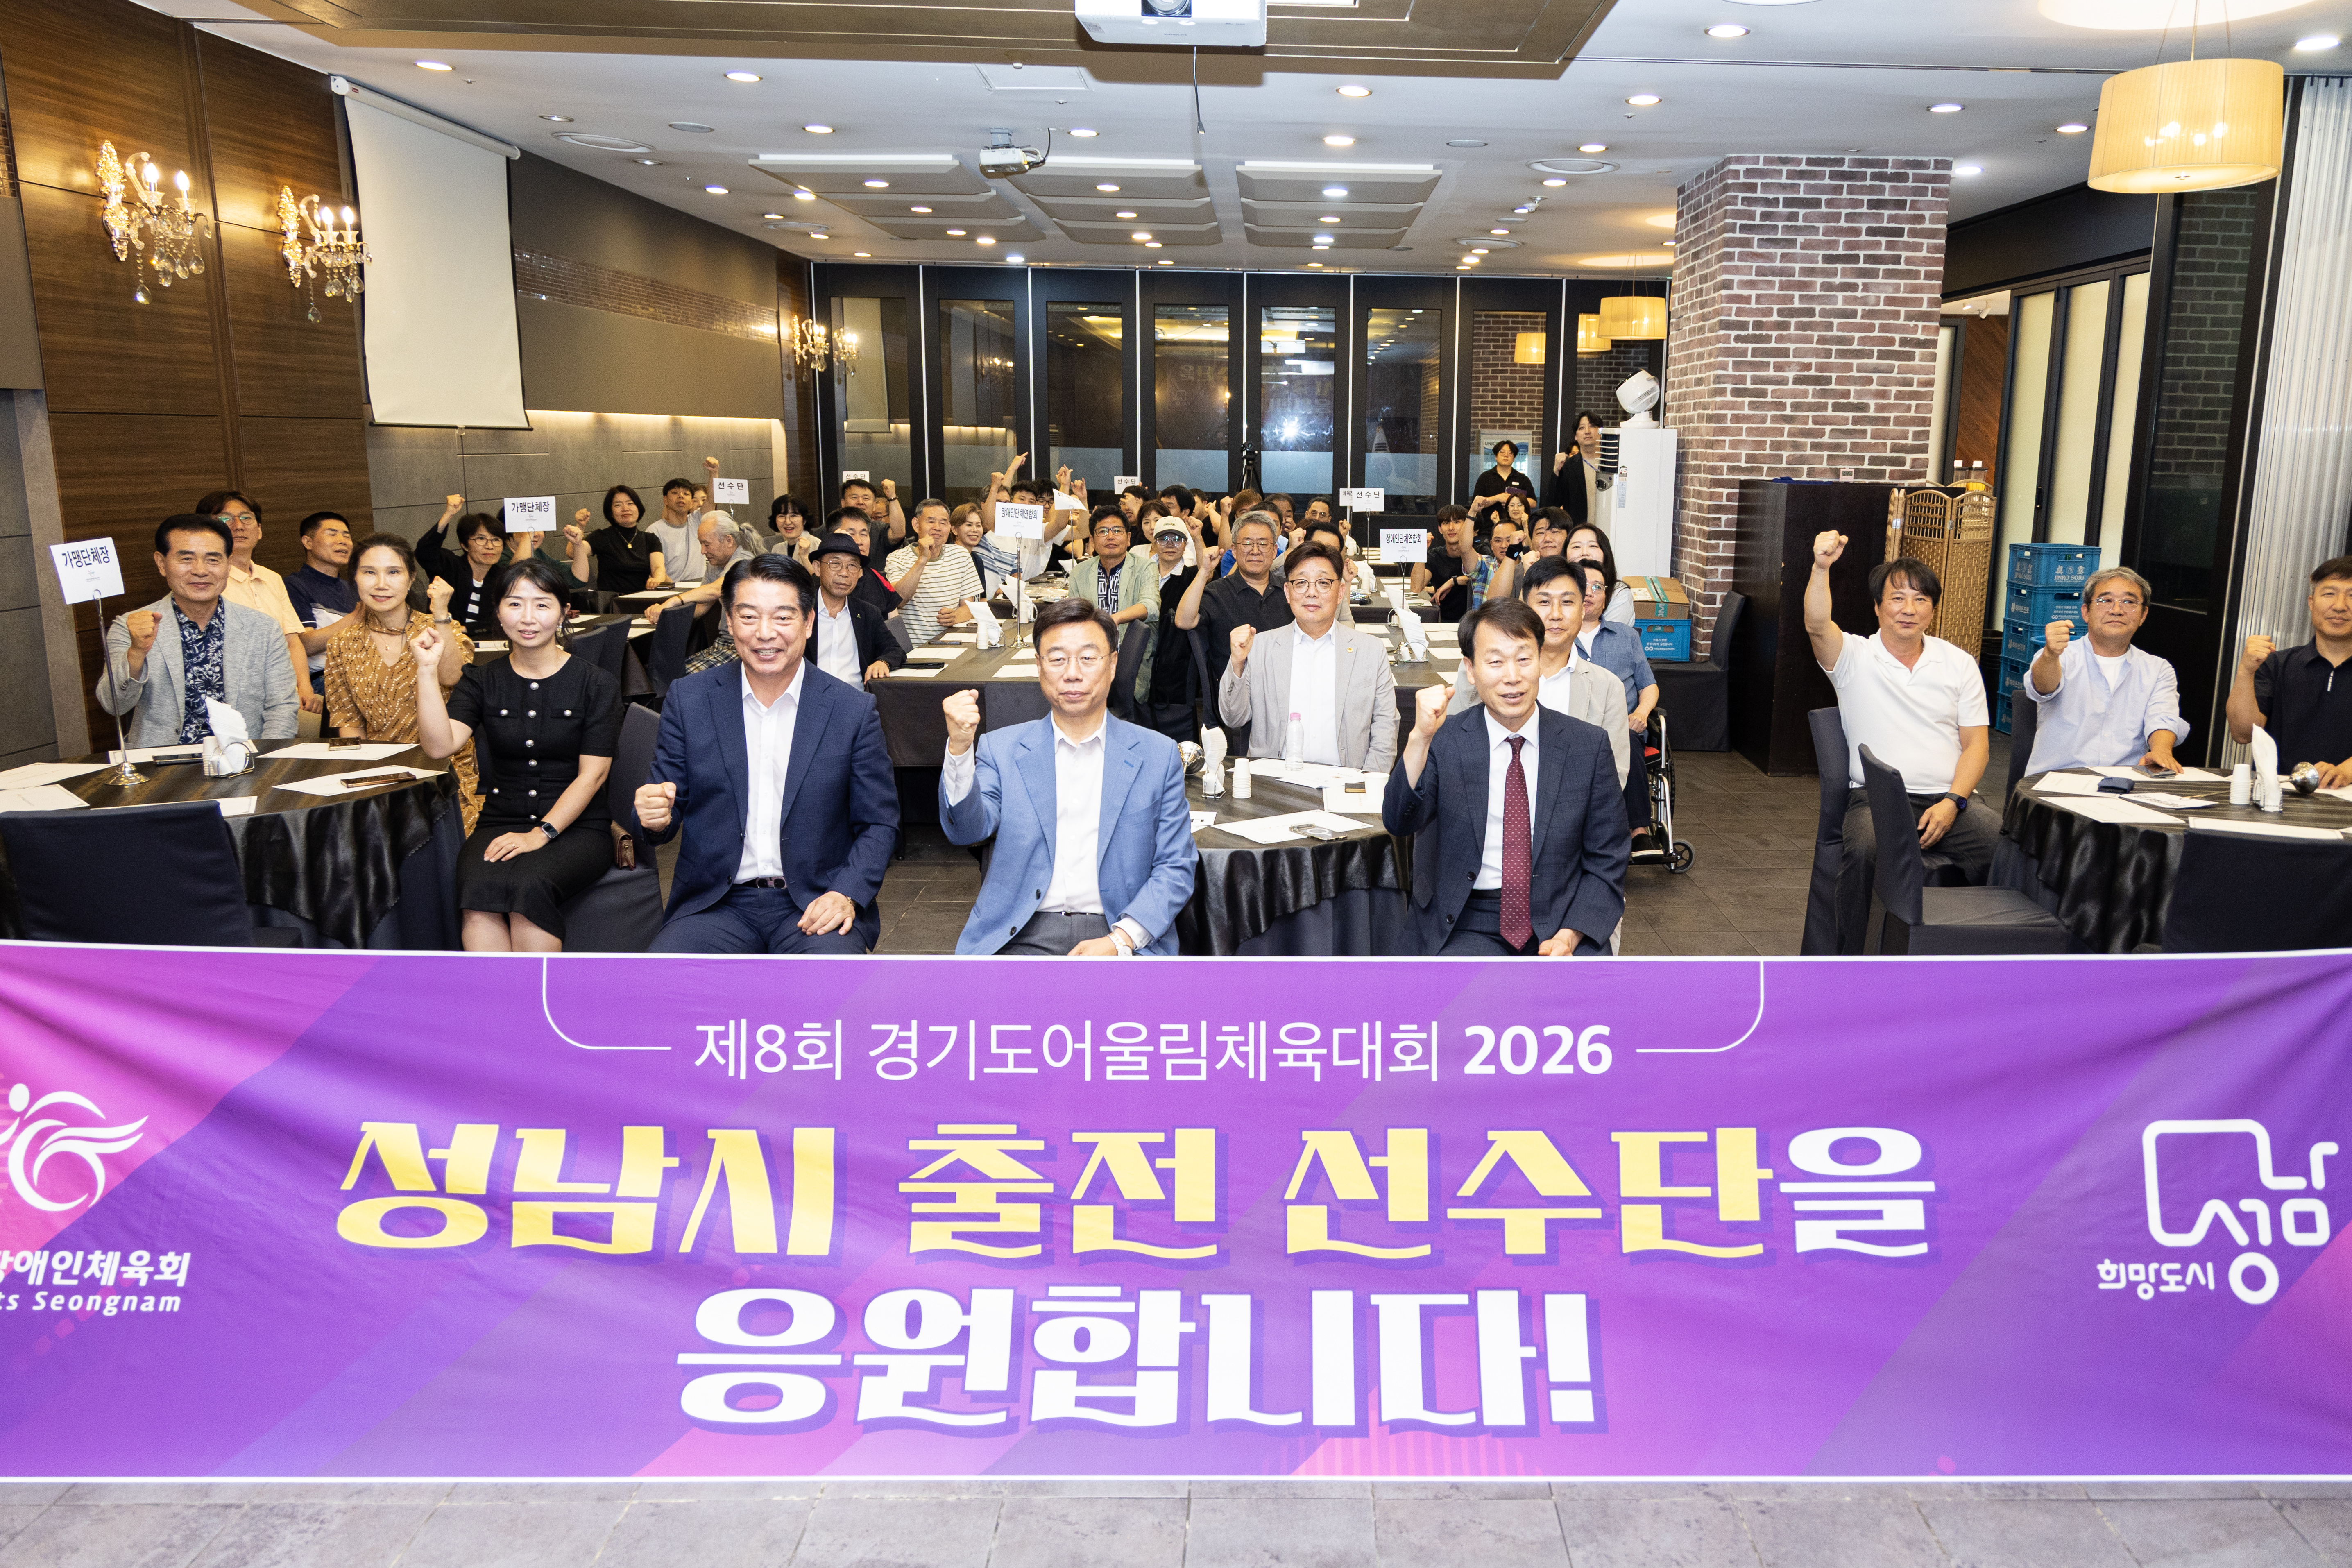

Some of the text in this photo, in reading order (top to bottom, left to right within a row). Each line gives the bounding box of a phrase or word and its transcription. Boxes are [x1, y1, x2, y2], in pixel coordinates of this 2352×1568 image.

[718, 481, 743, 490] 선수단
[511, 501, 550, 513] 가맹단체장
[1001, 507, 1038, 520] 장애인단체연합회
[1386, 533, 1421, 544] 장애인단체연합회
[62, 546, 110, 569] 가맹단체장
[695, 1019, 1613, 1082] 제8회 경기도어울림체육대회 2026
[336, 1121, 1936, 1259] 성남시 출전 선수단을
[2097, 1258, 2215, 1300] 희망도시
[32, 1291, 181, 1316] Seongnam
[676, 1286, 1595, 1427] 응원합니다!
